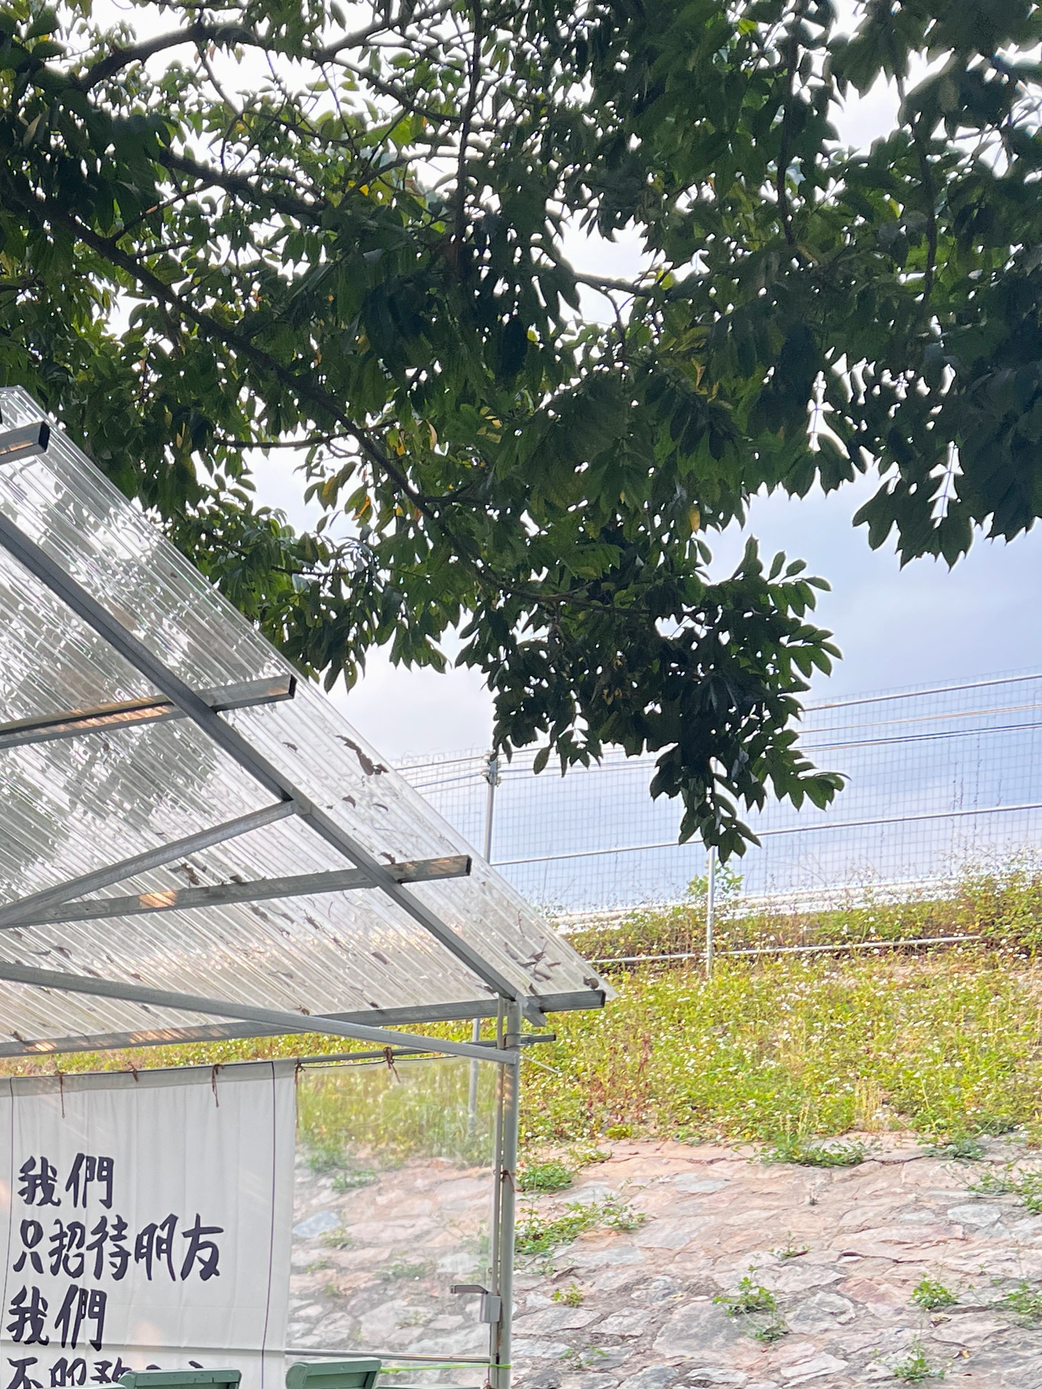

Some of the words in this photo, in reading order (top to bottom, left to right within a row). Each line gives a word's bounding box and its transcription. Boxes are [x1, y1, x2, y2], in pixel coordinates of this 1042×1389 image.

[18, 1153, 114, 1209] 我們
[13, 1213, 224, 1281] 只招待朋友
[6, 1284, 107, 1351] 我們
